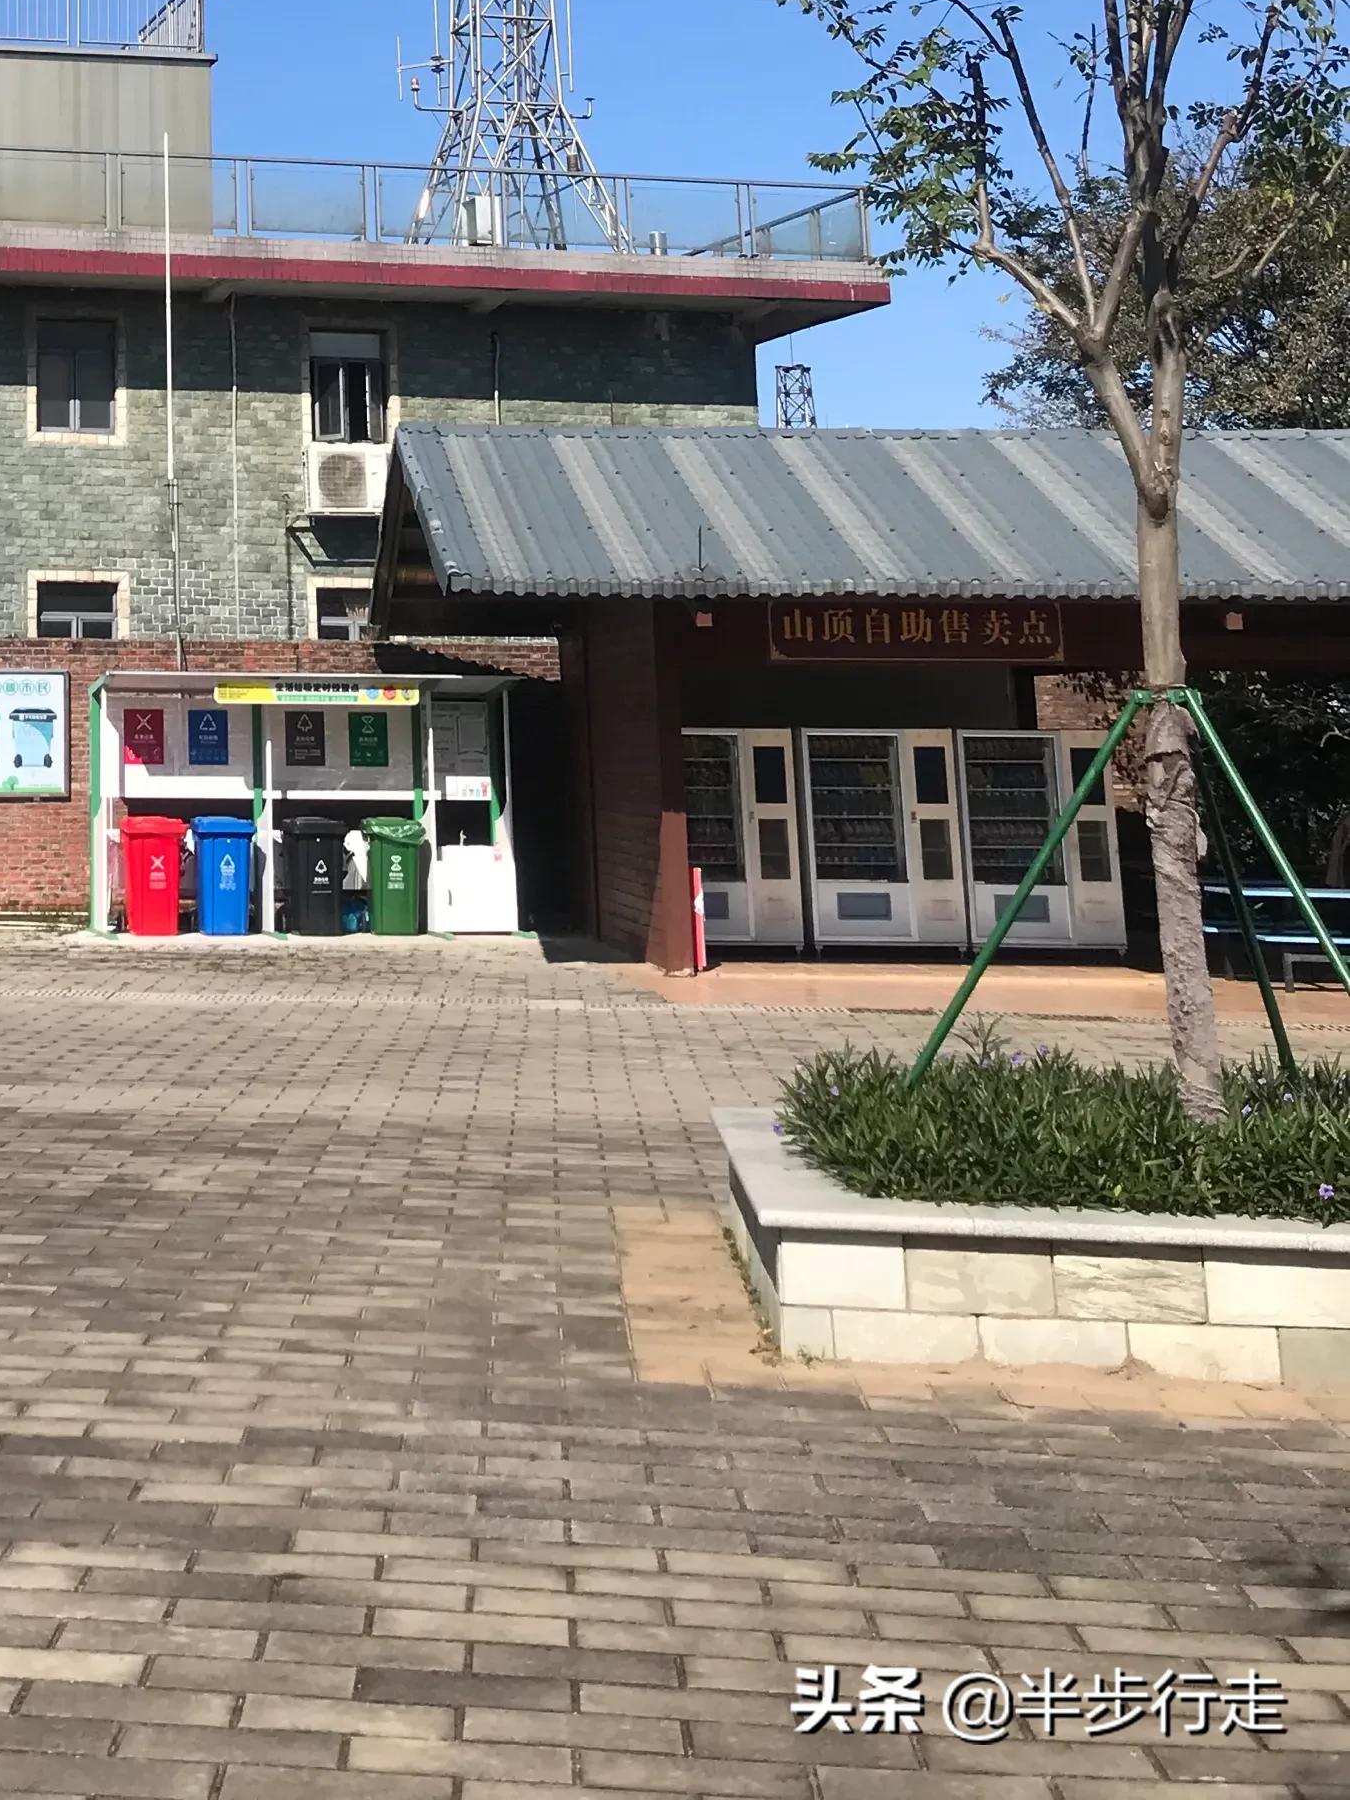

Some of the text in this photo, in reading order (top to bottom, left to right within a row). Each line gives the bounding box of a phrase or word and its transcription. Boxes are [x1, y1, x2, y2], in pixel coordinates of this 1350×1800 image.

[782, 607, 1052, 645] 山顶自助售卖点
